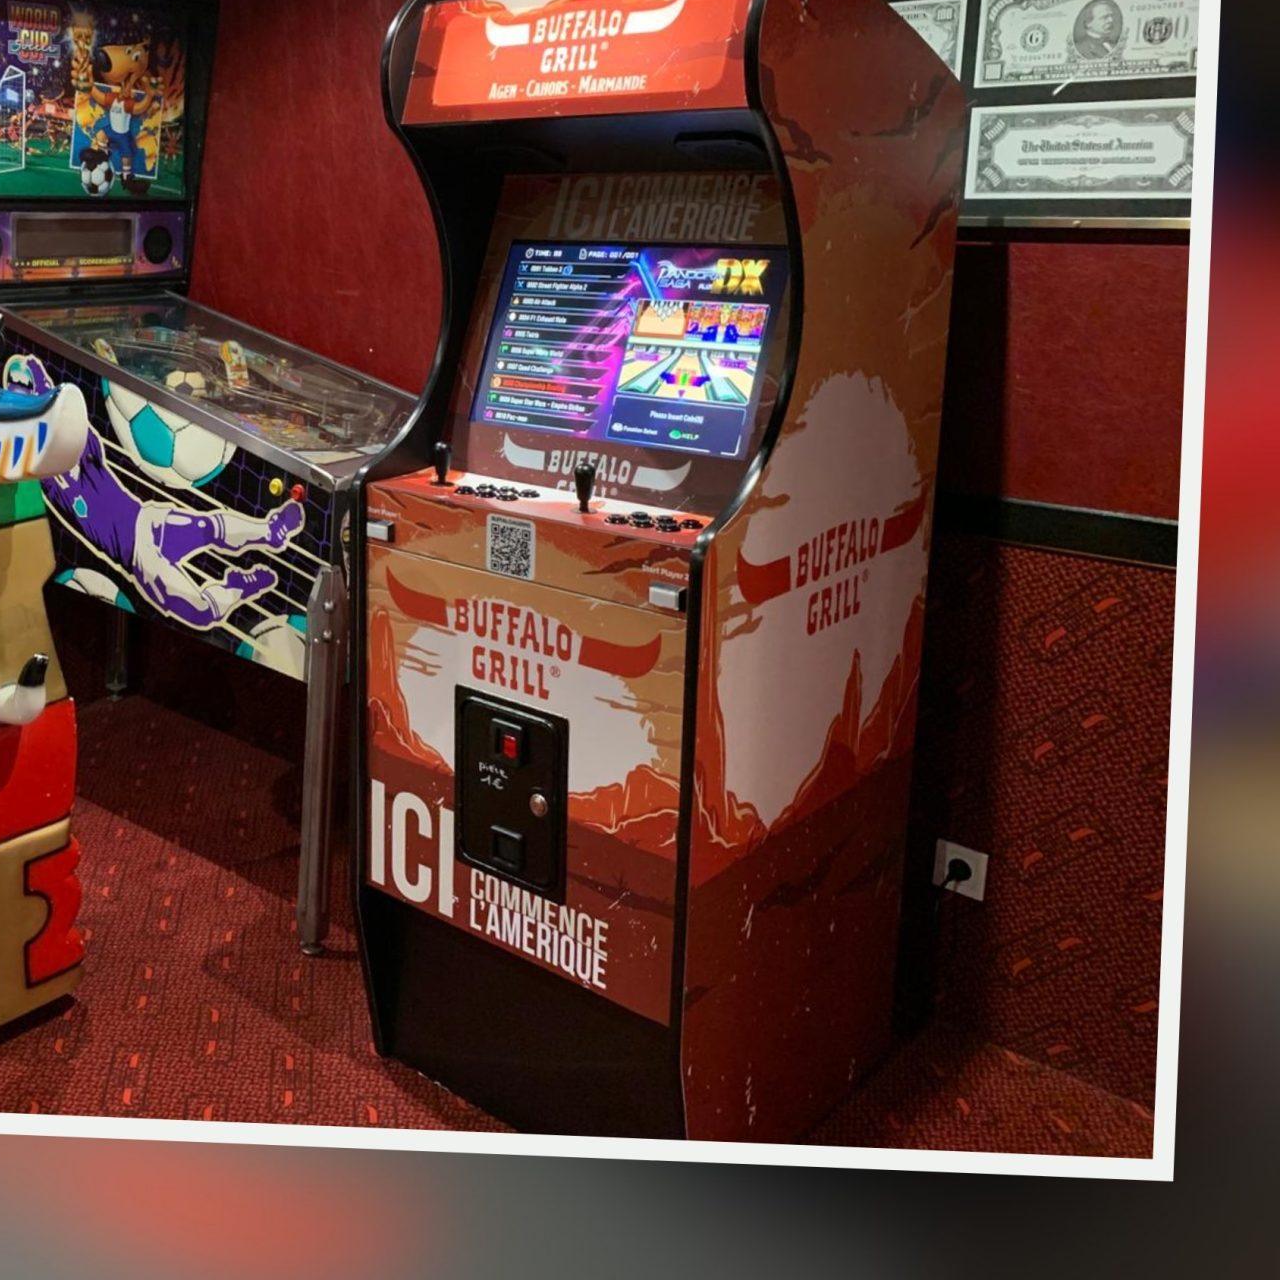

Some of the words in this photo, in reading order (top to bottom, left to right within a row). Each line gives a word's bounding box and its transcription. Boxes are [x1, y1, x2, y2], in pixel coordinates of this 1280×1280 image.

[9, 5, 58, 31] WORLD
[532, 9, 623, 44] BUFFALO
[547, 177, 616, 240] ICI
[795, 517, 880, 589] BUFFALO
[454, 597, 574, 662] BUFFALO
[370, 778, 455, 919] ICI
[469, 898, 608, 990] L'AMERIQUE
[470, 867, 609, 959] COMMENCE
